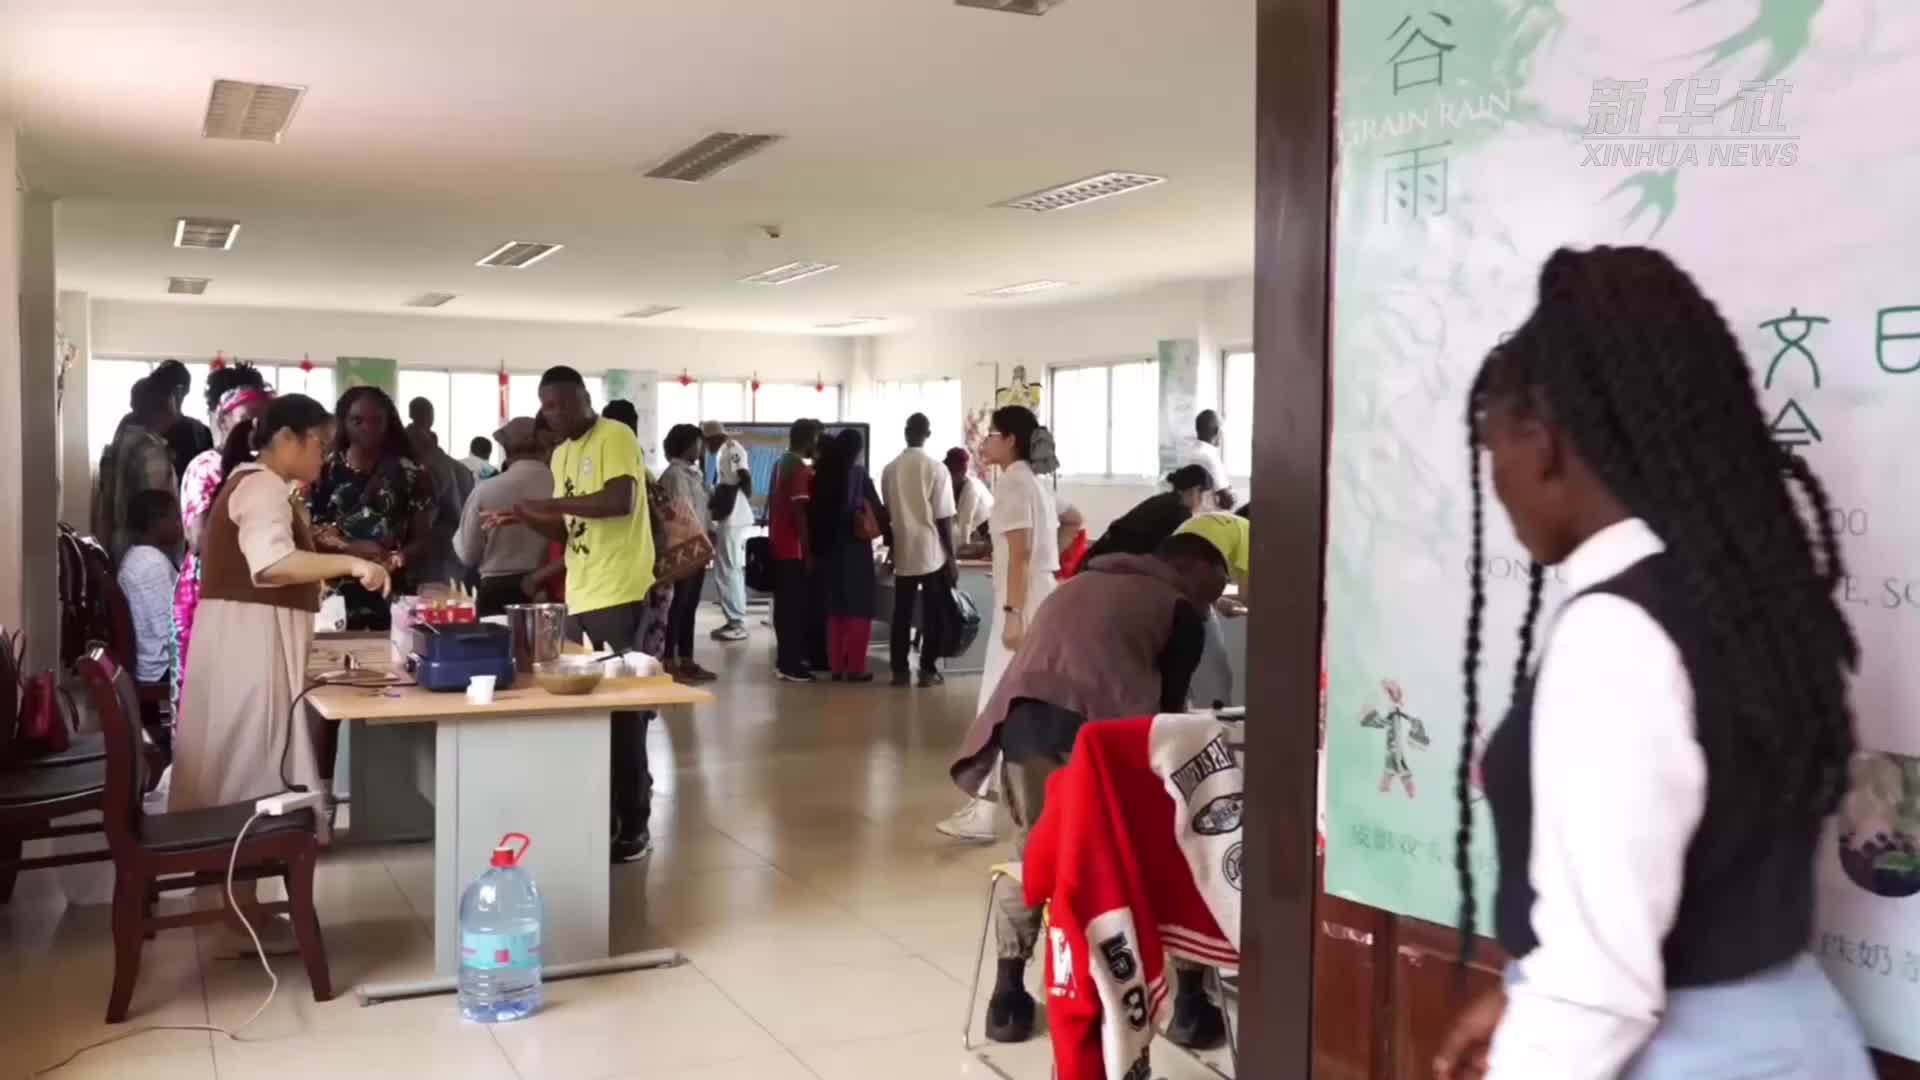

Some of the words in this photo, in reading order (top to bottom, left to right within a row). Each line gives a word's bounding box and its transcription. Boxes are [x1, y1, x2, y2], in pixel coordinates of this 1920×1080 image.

[1385, 11, 1457, 96] 谷
[1438, 87, 1512, 130] RAIN
[1382, 138, 1453, 225] 雨
